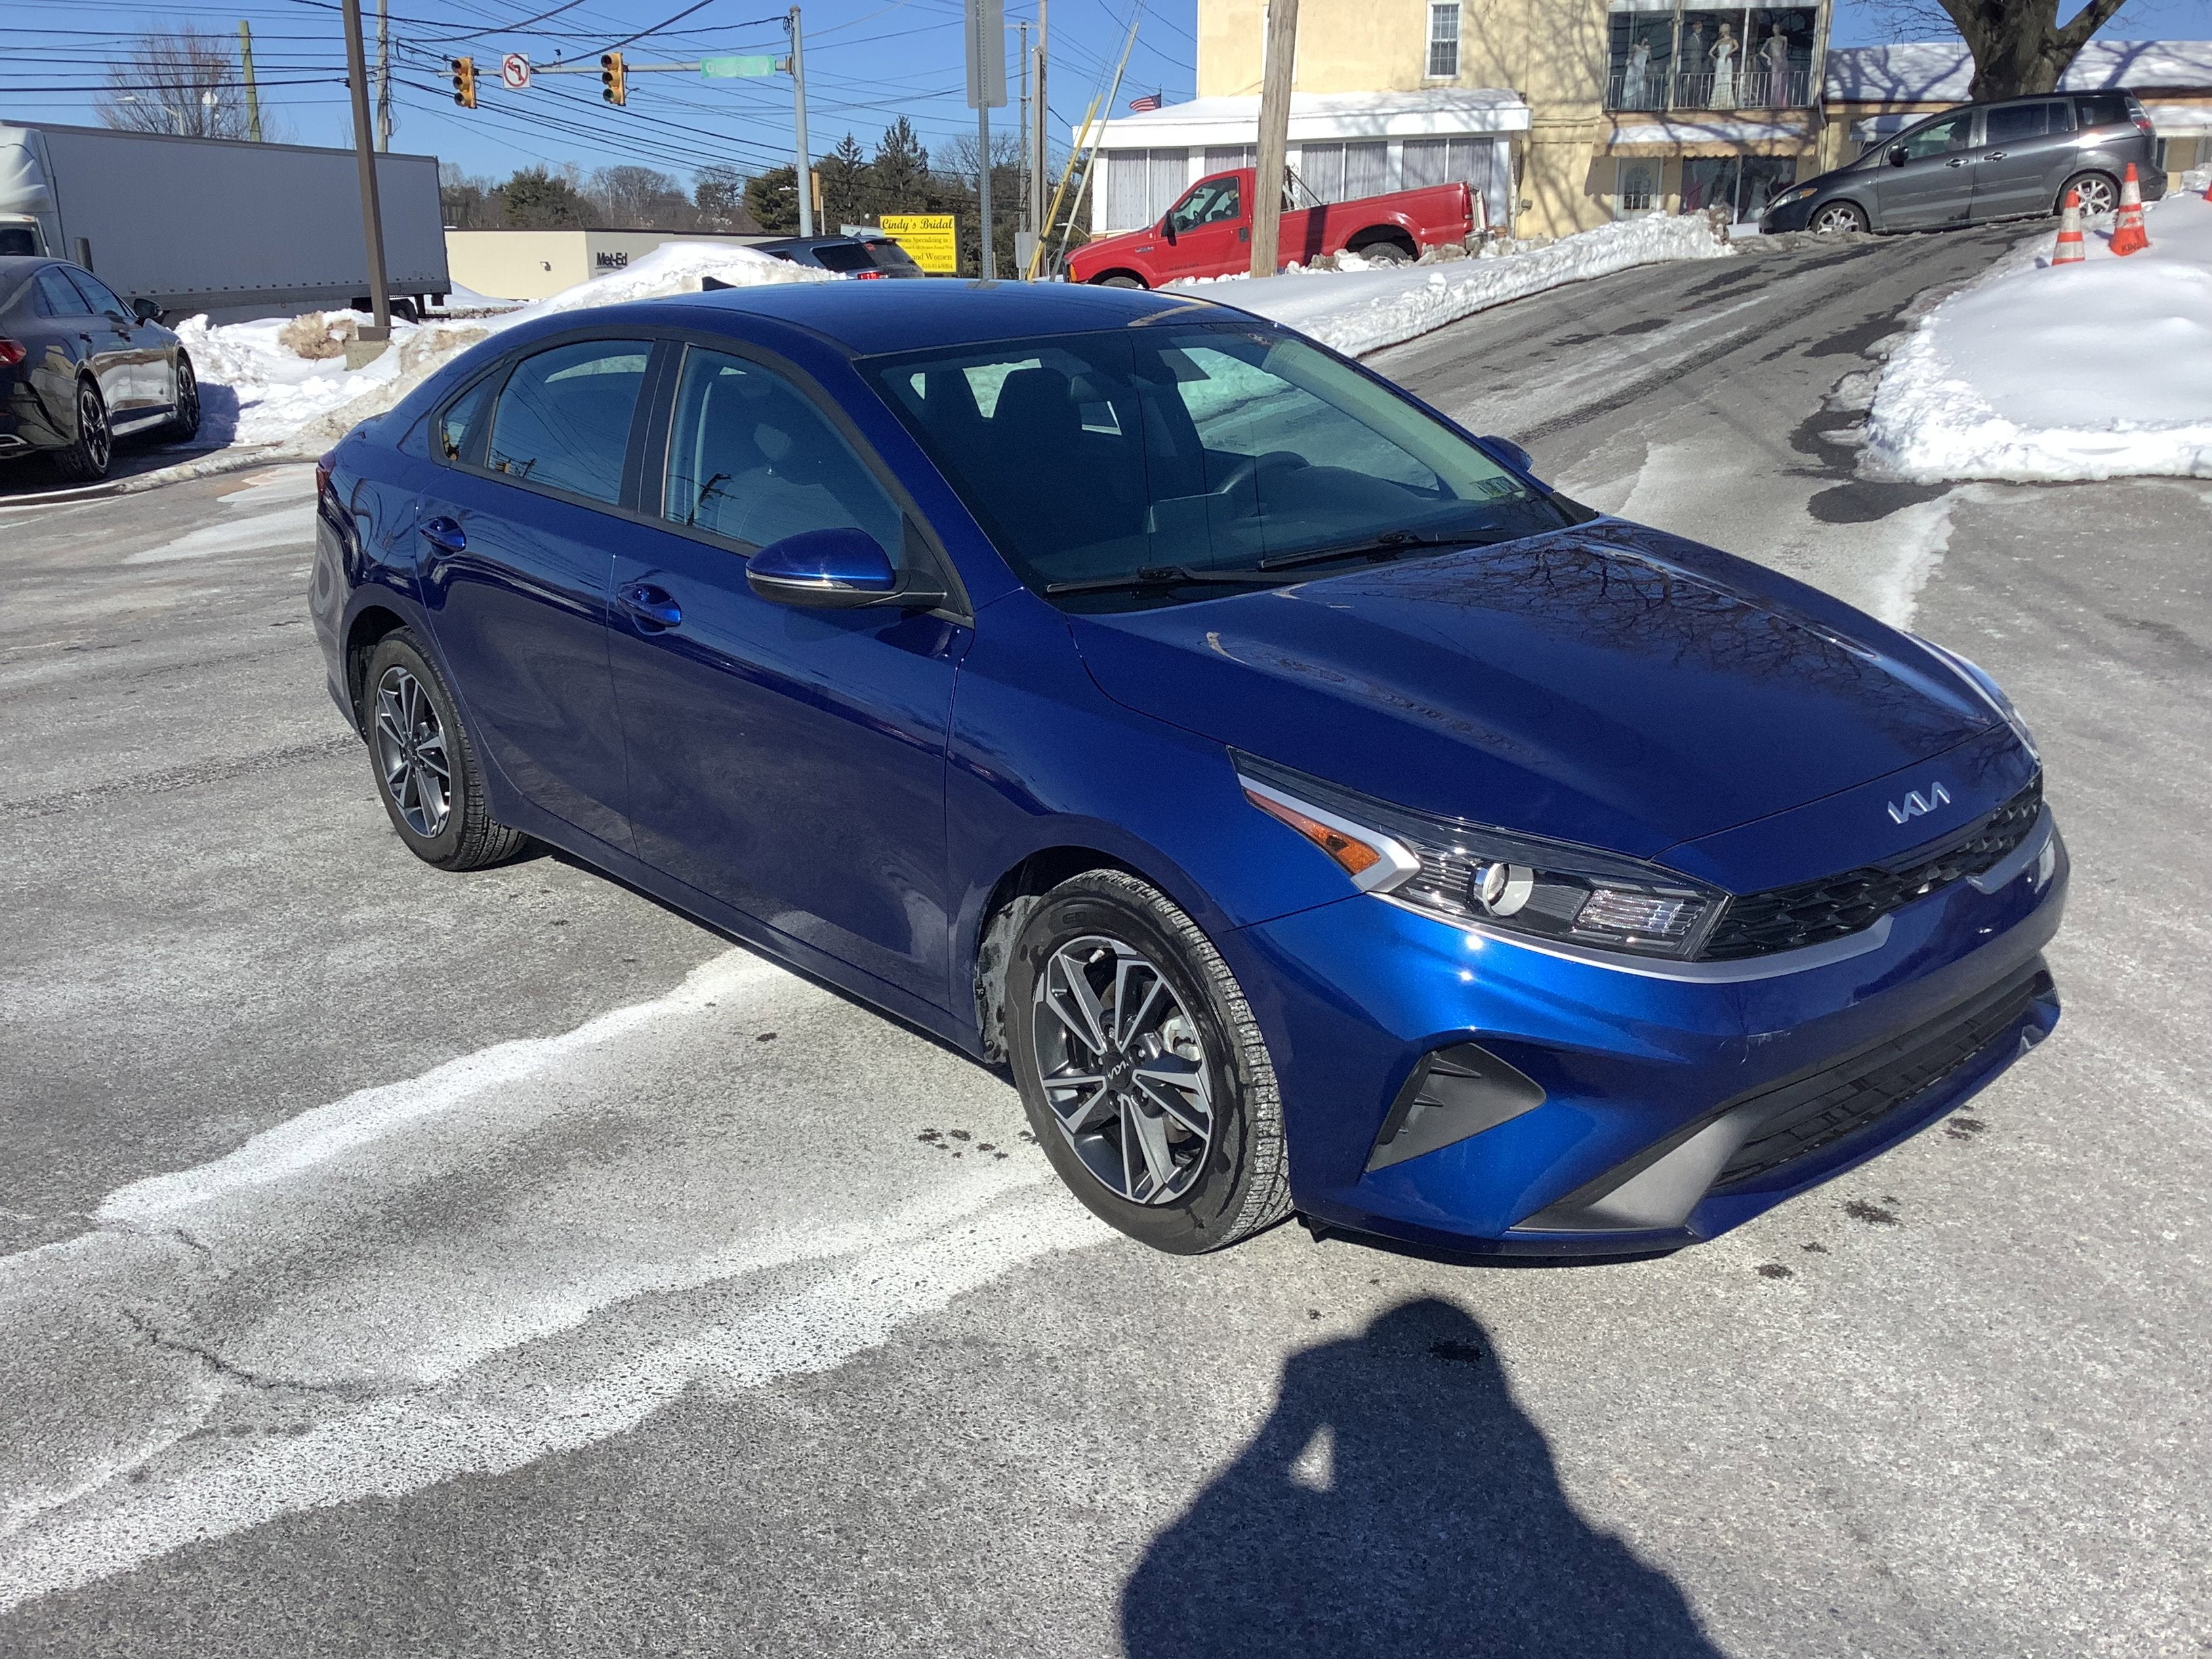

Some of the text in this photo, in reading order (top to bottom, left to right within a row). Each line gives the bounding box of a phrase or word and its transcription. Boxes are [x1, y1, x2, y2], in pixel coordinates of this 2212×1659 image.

[882, 218, 953, 232] Cindy's Bridal
[596, 252, 628, 266] Met-Ed
